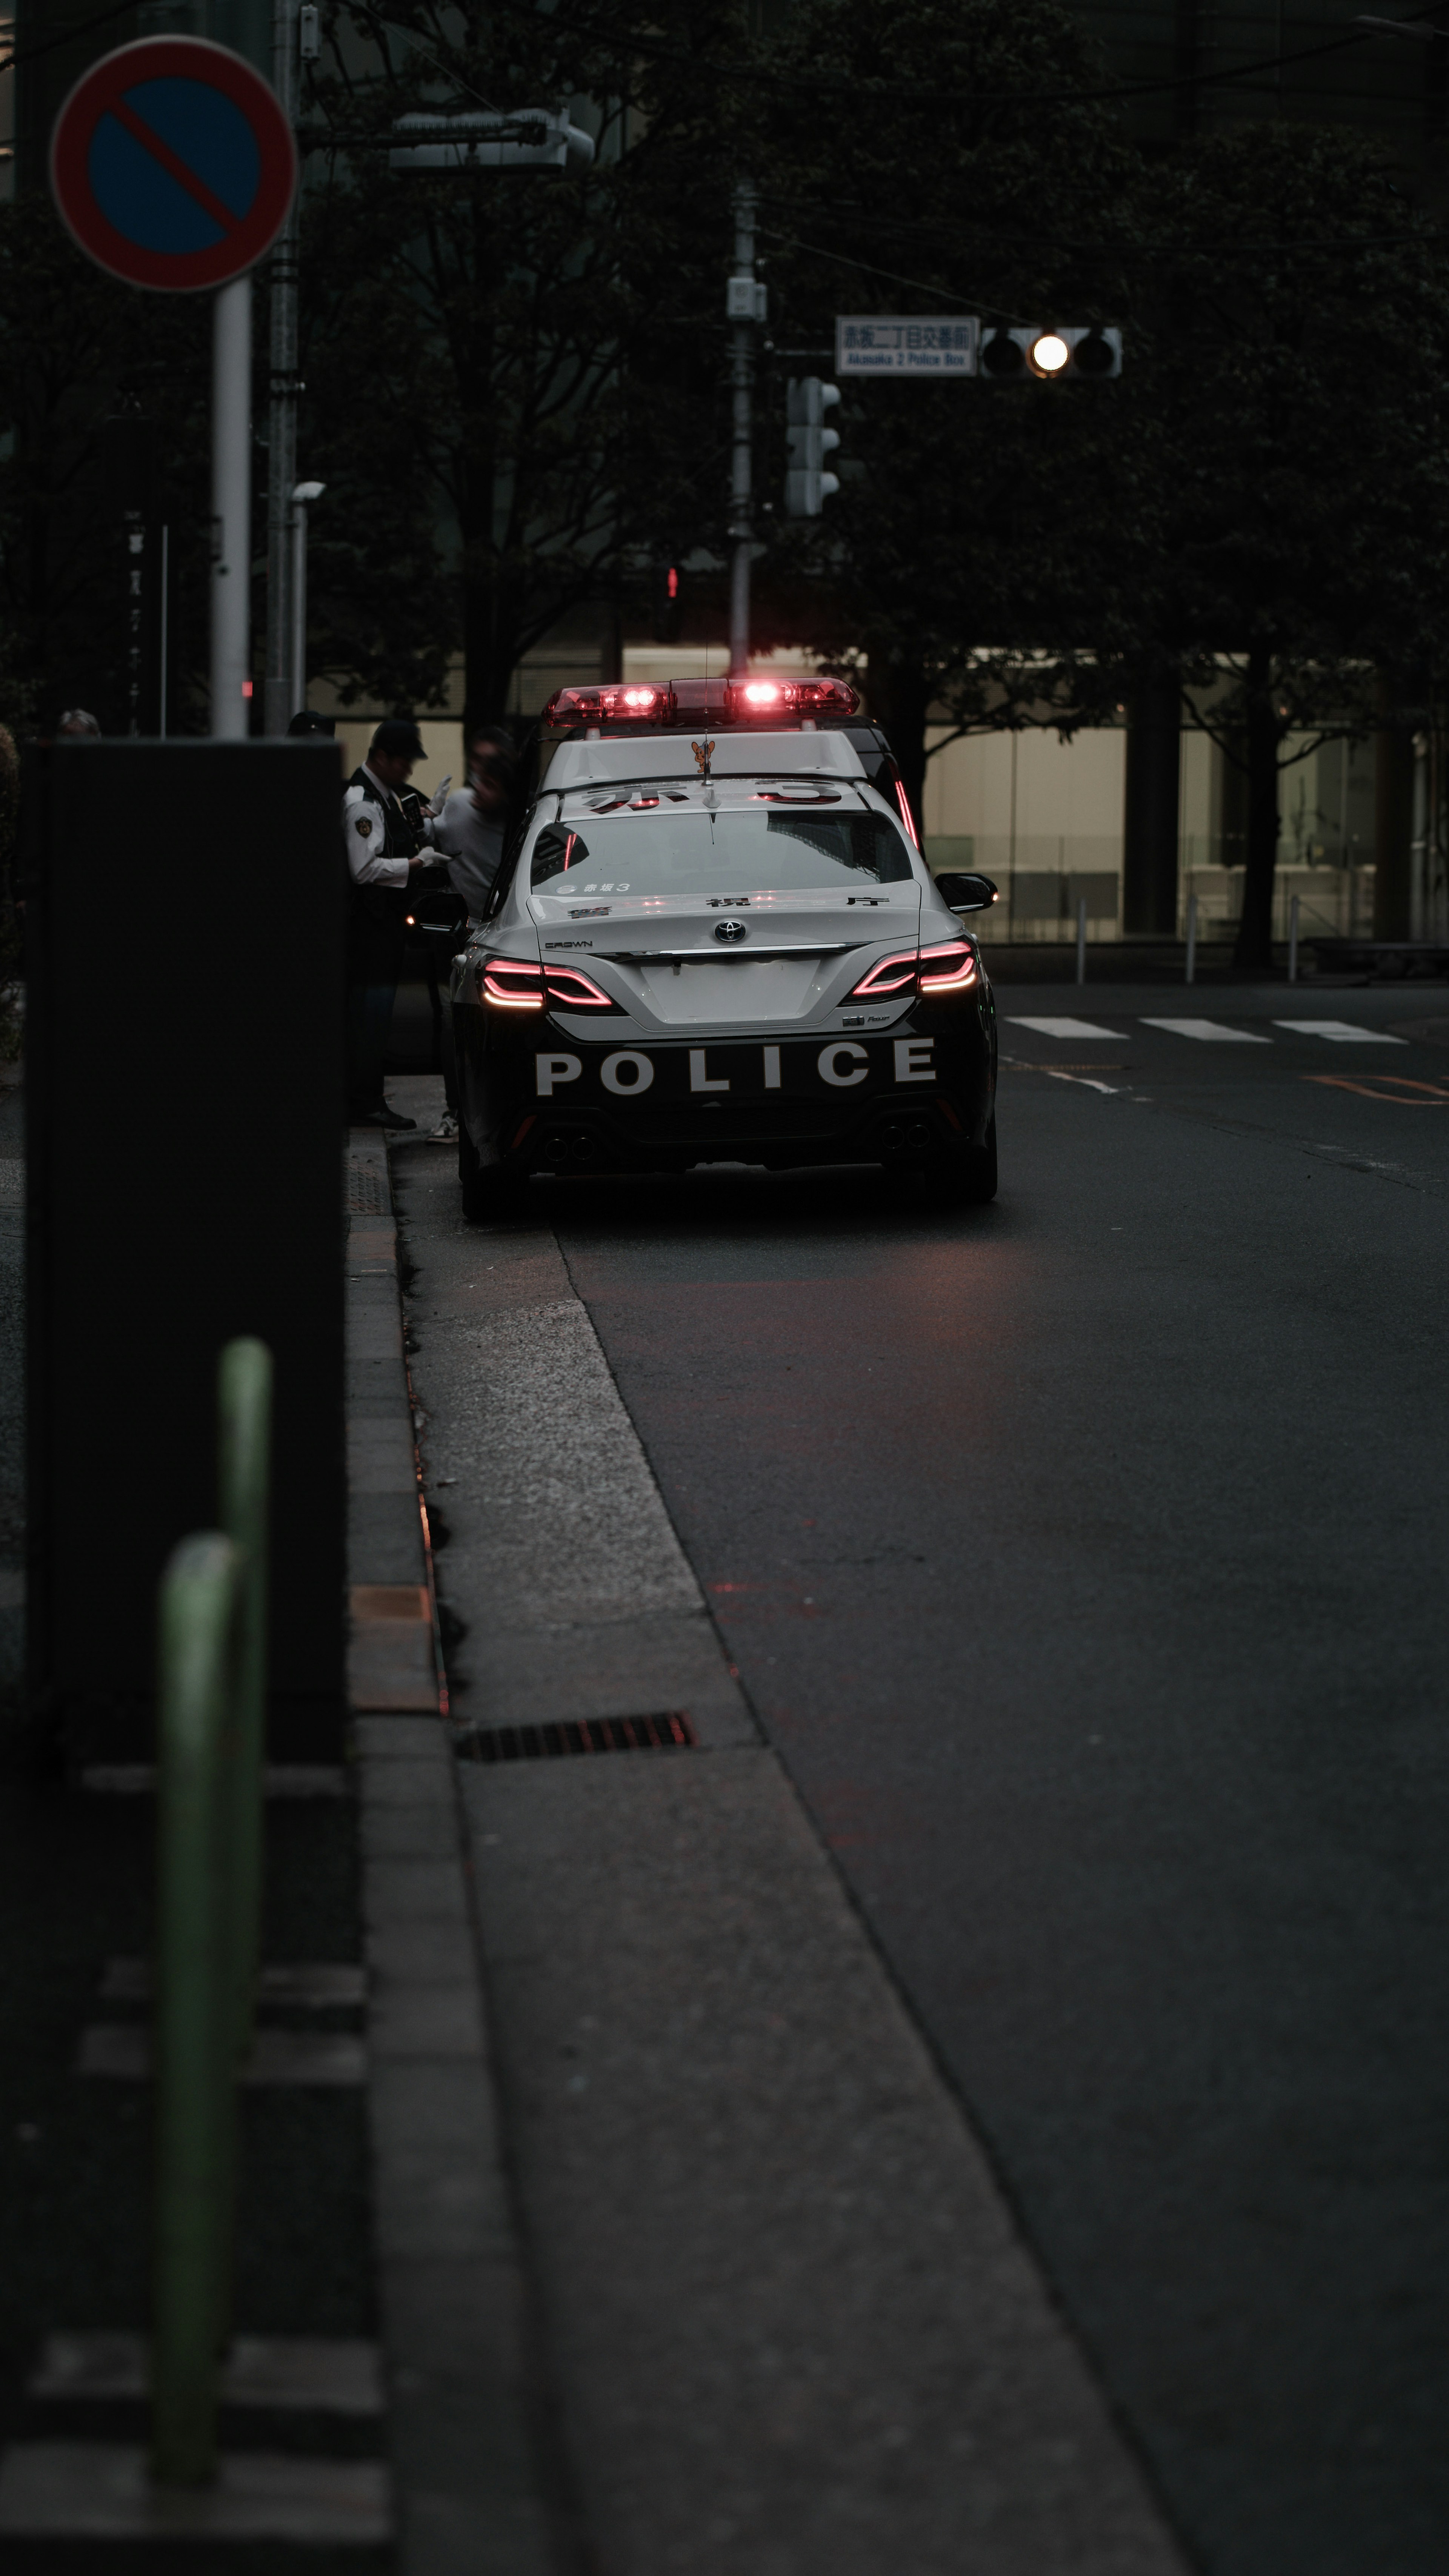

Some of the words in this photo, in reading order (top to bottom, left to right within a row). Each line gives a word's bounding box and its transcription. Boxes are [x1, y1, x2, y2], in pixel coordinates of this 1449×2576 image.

[898, 353, 904, 365] 2
[908, 352, 940, 365] Police
[946, 353, 964, 365] Box
[535, 1037, 938, 1097] POLICE
